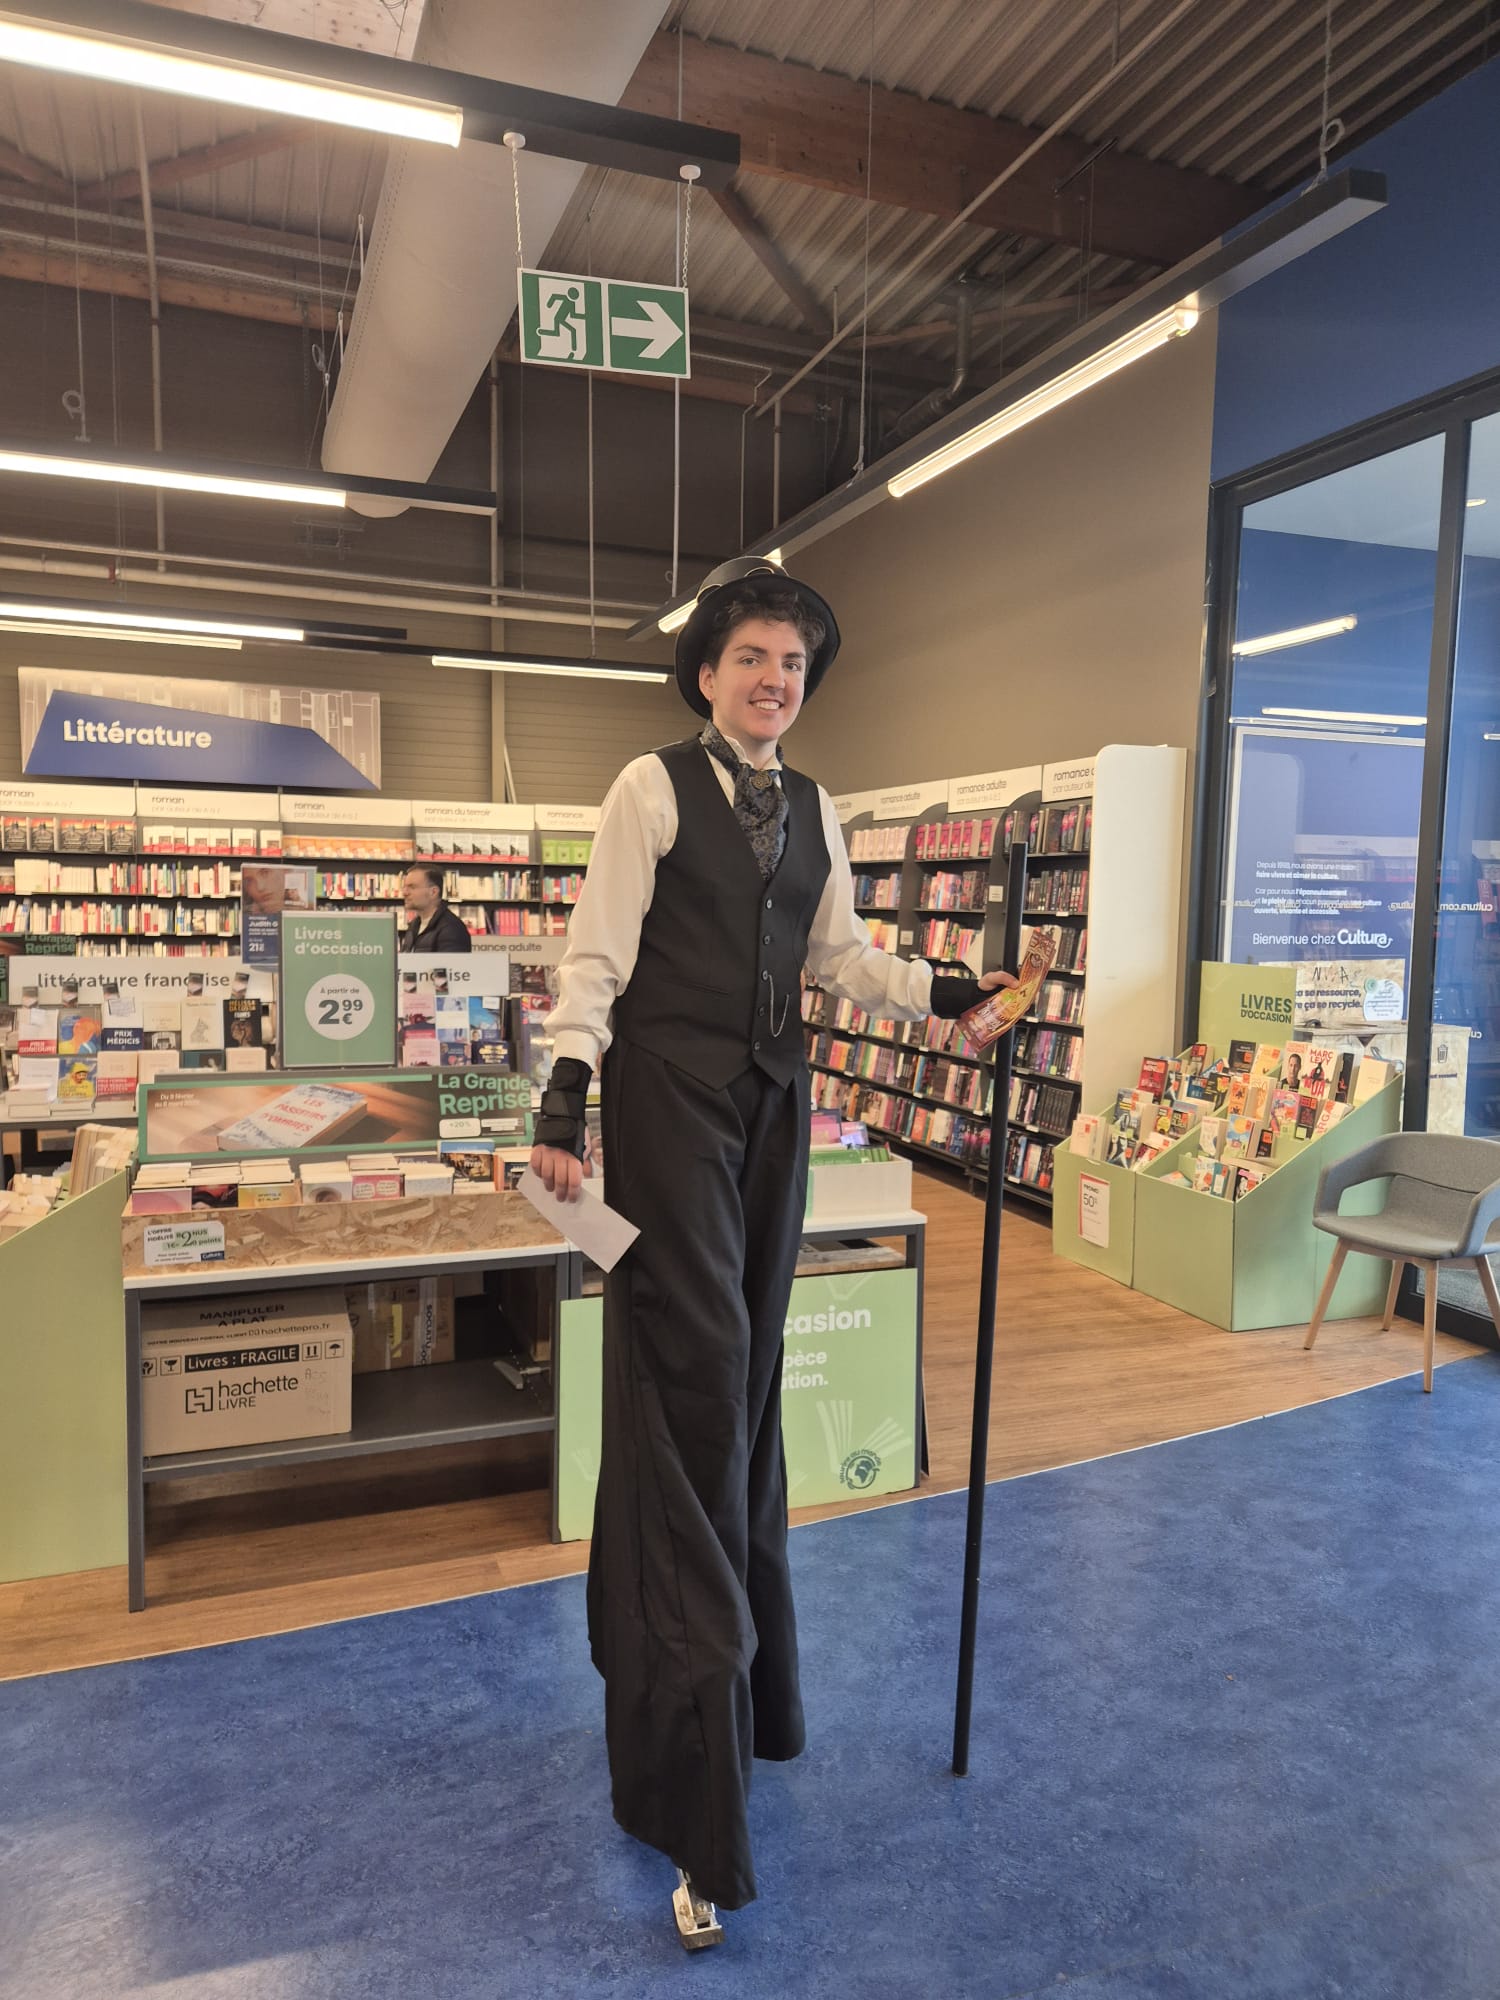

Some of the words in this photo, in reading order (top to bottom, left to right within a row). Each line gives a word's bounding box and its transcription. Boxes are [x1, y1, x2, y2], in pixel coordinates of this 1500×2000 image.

[63, 718, 213, 749] Littérature
[1054, 767, 1090, 781] romance
[0, 790, 35, 798] roman
[151, 796, 185, 804] roman
[293, 802, 326, 810] roman
[424, 807, 453, 815] roman
[455, 807, 466, 816] du
[467, 808, 491, 817] terroir
[1255, 887, 1266, 895] Car
[294, 926, 343, 940] Livres
[1252, 932, 1309, 945] Bienvenue
[1310, 933, 1336, 945] chez
[1337, 928, 1394, 949] Cultura
[25, 943, 75, 955] Reprise
[294, 942, 384, 955] d'occasion
[471, 944, 507, 952] mance
[508, 942, 542, 952] adulte
[37, 972, 138, 989] littérature
[144, 972, 230, 988] franise
[327, 987, 349, 996] partir
[1241, 993, 1293, 1014] LIVRES
[1240, 1009, 1292, 1025] D'OCCASION
[114, 1029, 132, 1037] PRIX
[1310, 1048, 1335, 1060] MARC
[1310, 1055, 1331, 1066] LEVY
[438, 1072, 460, 1089] La
[463, 1072, 531, 1092] Grande
[439, 1091, 531, 1117] Reprise
[147, 1227, 172, 1236] L'OFFRE
[198, 1237, 222, 1246] points
[200, 1304, 286, 1321] MANIPULER
[230, 1315, 268, 1325] PLAT
[783, 1304, 872, 1337] casion
[260, 1322, 331, 1337] hachettepro.fr
[187, 1354, 229, 1371] Livres
[240, 1347, 298, 1365] FRAGILE
[783, 1349, 828, 1373] pèce
[218, 1375, 299, 1398] hachette
[218, 1395, 257, 1411] LIVRE
